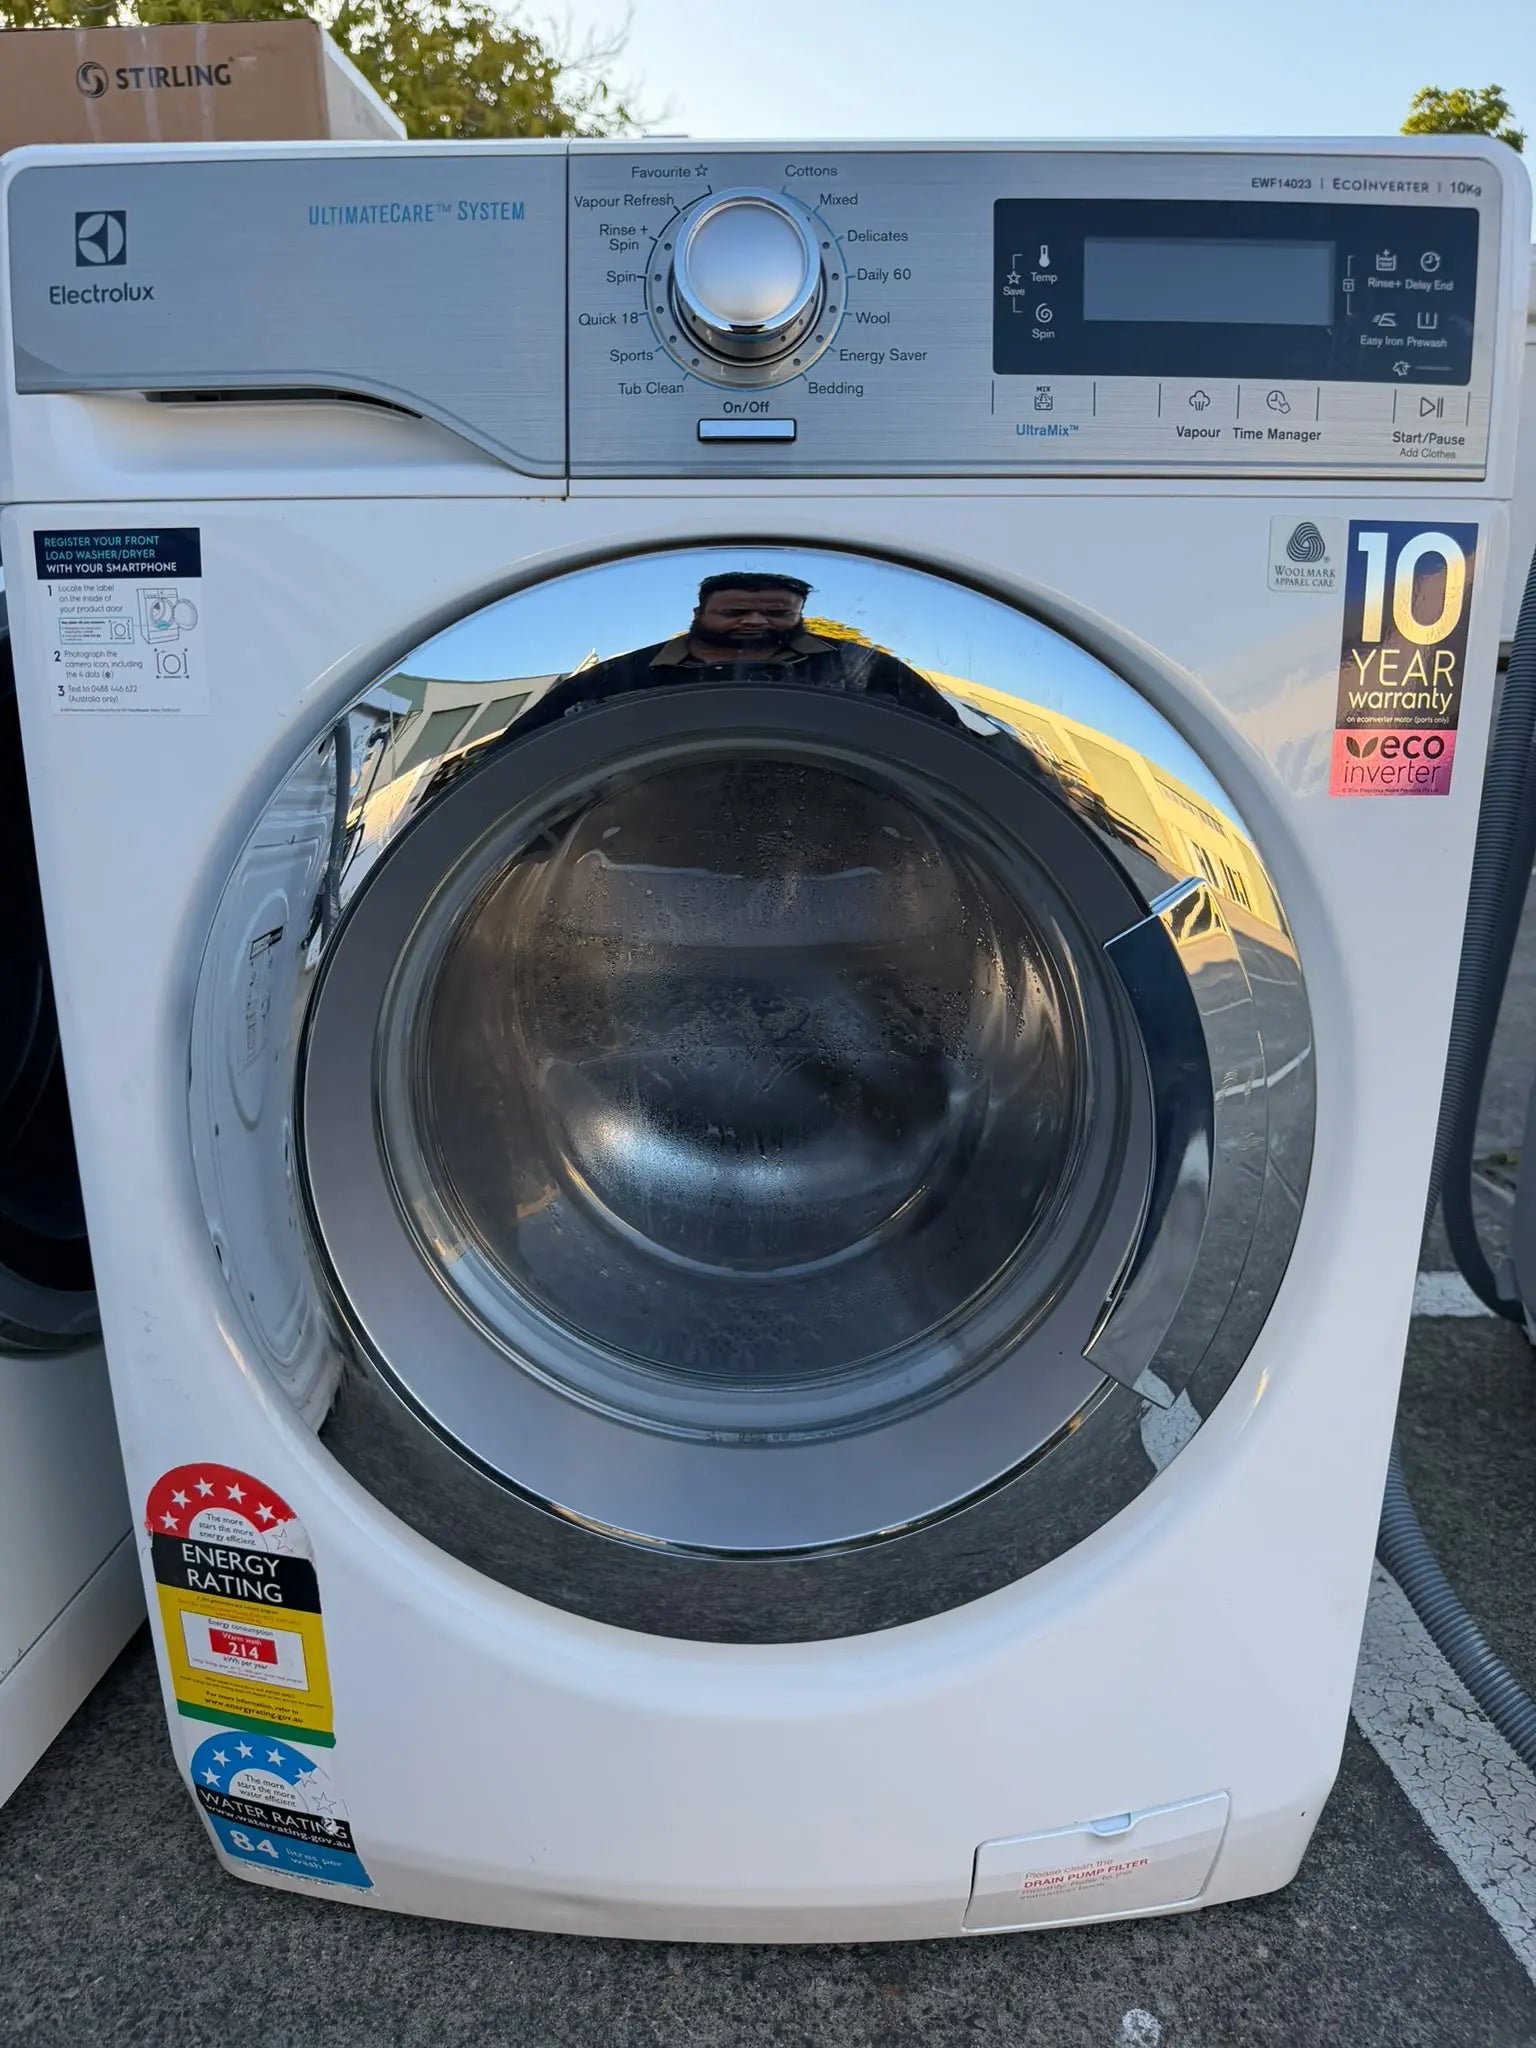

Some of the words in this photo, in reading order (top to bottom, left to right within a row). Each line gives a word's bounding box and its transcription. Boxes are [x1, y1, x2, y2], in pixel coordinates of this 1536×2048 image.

[116, 62, 232, 90] STIRLING
[631, 166, 690, 179] Favourite
[785, 165, 838, 177] Cottons
[1251, 178, 1312, 190] EWF14023
[1450, 181, 1482, 197] 10Kg
[574, 197, 619, 208] Vapour
[624, 194, 674, 207] Refresh
[820, 194, 858, 206] Mixed
[457, 200, 526, 222] SYSTEM
[599, 224, 636, 236] Rinse
[847, 230, 909, 242] Delicates
[609, 239, 639, 252] Spin
[606, 271, 636, 285] Spin
[857, 269, 888, 282] Daily
[893, 268, 912, 280] 60
[1031, 272, 1058, 285] Temp
[1003, 286, 1025, 296] Save
[1367, 277, 1402, 288] Rinse+
[1405, 279, 1431, 293] Delay
[1434, 280, 1454, 291] End
[49, 282, 155, 305] Electrolux
[579, 313, 617, 326] Quick
[623, 313, 638, 324] 18
[856, 312, 890, 324] Wool
[1032, 329, 1055, 341] Spin
[1360, 335, 1382, 348] Easy
[1385, 336, 1403, 346] Iron
[1406, 336, 1447, 348] Prewash
[609, 350, 654, 363] Sports
[839, 350, 885, 364] Energy
[890, 350, 927, 362] Saver
[618, 383, 642, 395] Tub
[646, 382, 684, 394] Clean
[808, 383, 864, 397] Bedding
[723, 401, 769, 414] On/Off
[1176, 426, 1221, 439] Vapour
[1232, 427, 1263, 440] Time
[1267, 428, 1321, 443] Manager
[1392, 431, 1465, 446] Start/Pause
[1400, 448, 1418, 458] Add
[1421, 449, 1456, 459] Clothes
[44, 537, 91, 547] REGISTER
[93, 536, 122, 546] YOUR
[125, 535, 160, 546] FRONT
[45, 550, 73, 560] LOAD
[76, 549, 156, 560] WASHER/DRYER
[46, 564, 72, 573] WITH
[75, 563, 103, 573] YOUR
[106, 562, 177, 572] SMARTPHONE
[1274, 565, 1336, 578] WOOLMARK
[96, 584, 114, 592] label
[1274, 577, 1309, 587] APPAREL
[1312, 578, 1334, 588] CARE
[1358, 531, 1466, 645] 10
[47, 585, 52, 596] 1
[54, 650, 61, 662] 2
[1351, 648, 1456, 687] YEAR
[57, 685, 65, 697] 3
[1348, 687, 1453, 715] warranty
[1380, 735, 1445, 759] eco
[1344, 760, 1441, 784] inverter
[206, 1512, 220, 1521] The
[222, 1517, 244, 1526] more
[199, 1522, 216, 1530] stars
[219, 1524, 231, 1532] the
[233, 1527, 254, 1536] more
[200, 1531, 225, 1542] energy
[182, 1542, 280, 1578] ENERGY
[187, 1568, 283, 1603] RATING
[208, 1618, 230, 1629] Energy
[221, 1632, 245, 1643] Warm
[245, 1636, 262, 1646] wash
[228, 1642, 260, 1659] 214
[245, 1773, 261, 1784] The
[262, 1780, 285, 1791] more
[237, 1782, 256, 1791] stars
[258, 1785, 272, 1795] the
[273, 1789, 296, 1800] more
[200, 1788, 268, 1820] WATER
[238, 1789, 263, 1800] water
[264, 1794, 297, 1808] efficient
[205, 1804, 351, 1849] www.waterrating.gov.au
[229, 1829, 279, 1860] 84
[285, 1847, 319, 1863] litres
[321, 1857, 343, 1868] per
[290, 1857, 323, 1870] wash
[1024, 1876, 1064, 1889] DRAIN
[1067, 1868, 1105, 1880] PUMP
[1107, 1858, 1149, 1873] FILTER
[1025, 1869, 1061, 1880] Please
[1064, 1863, 1093, 1873] clean
